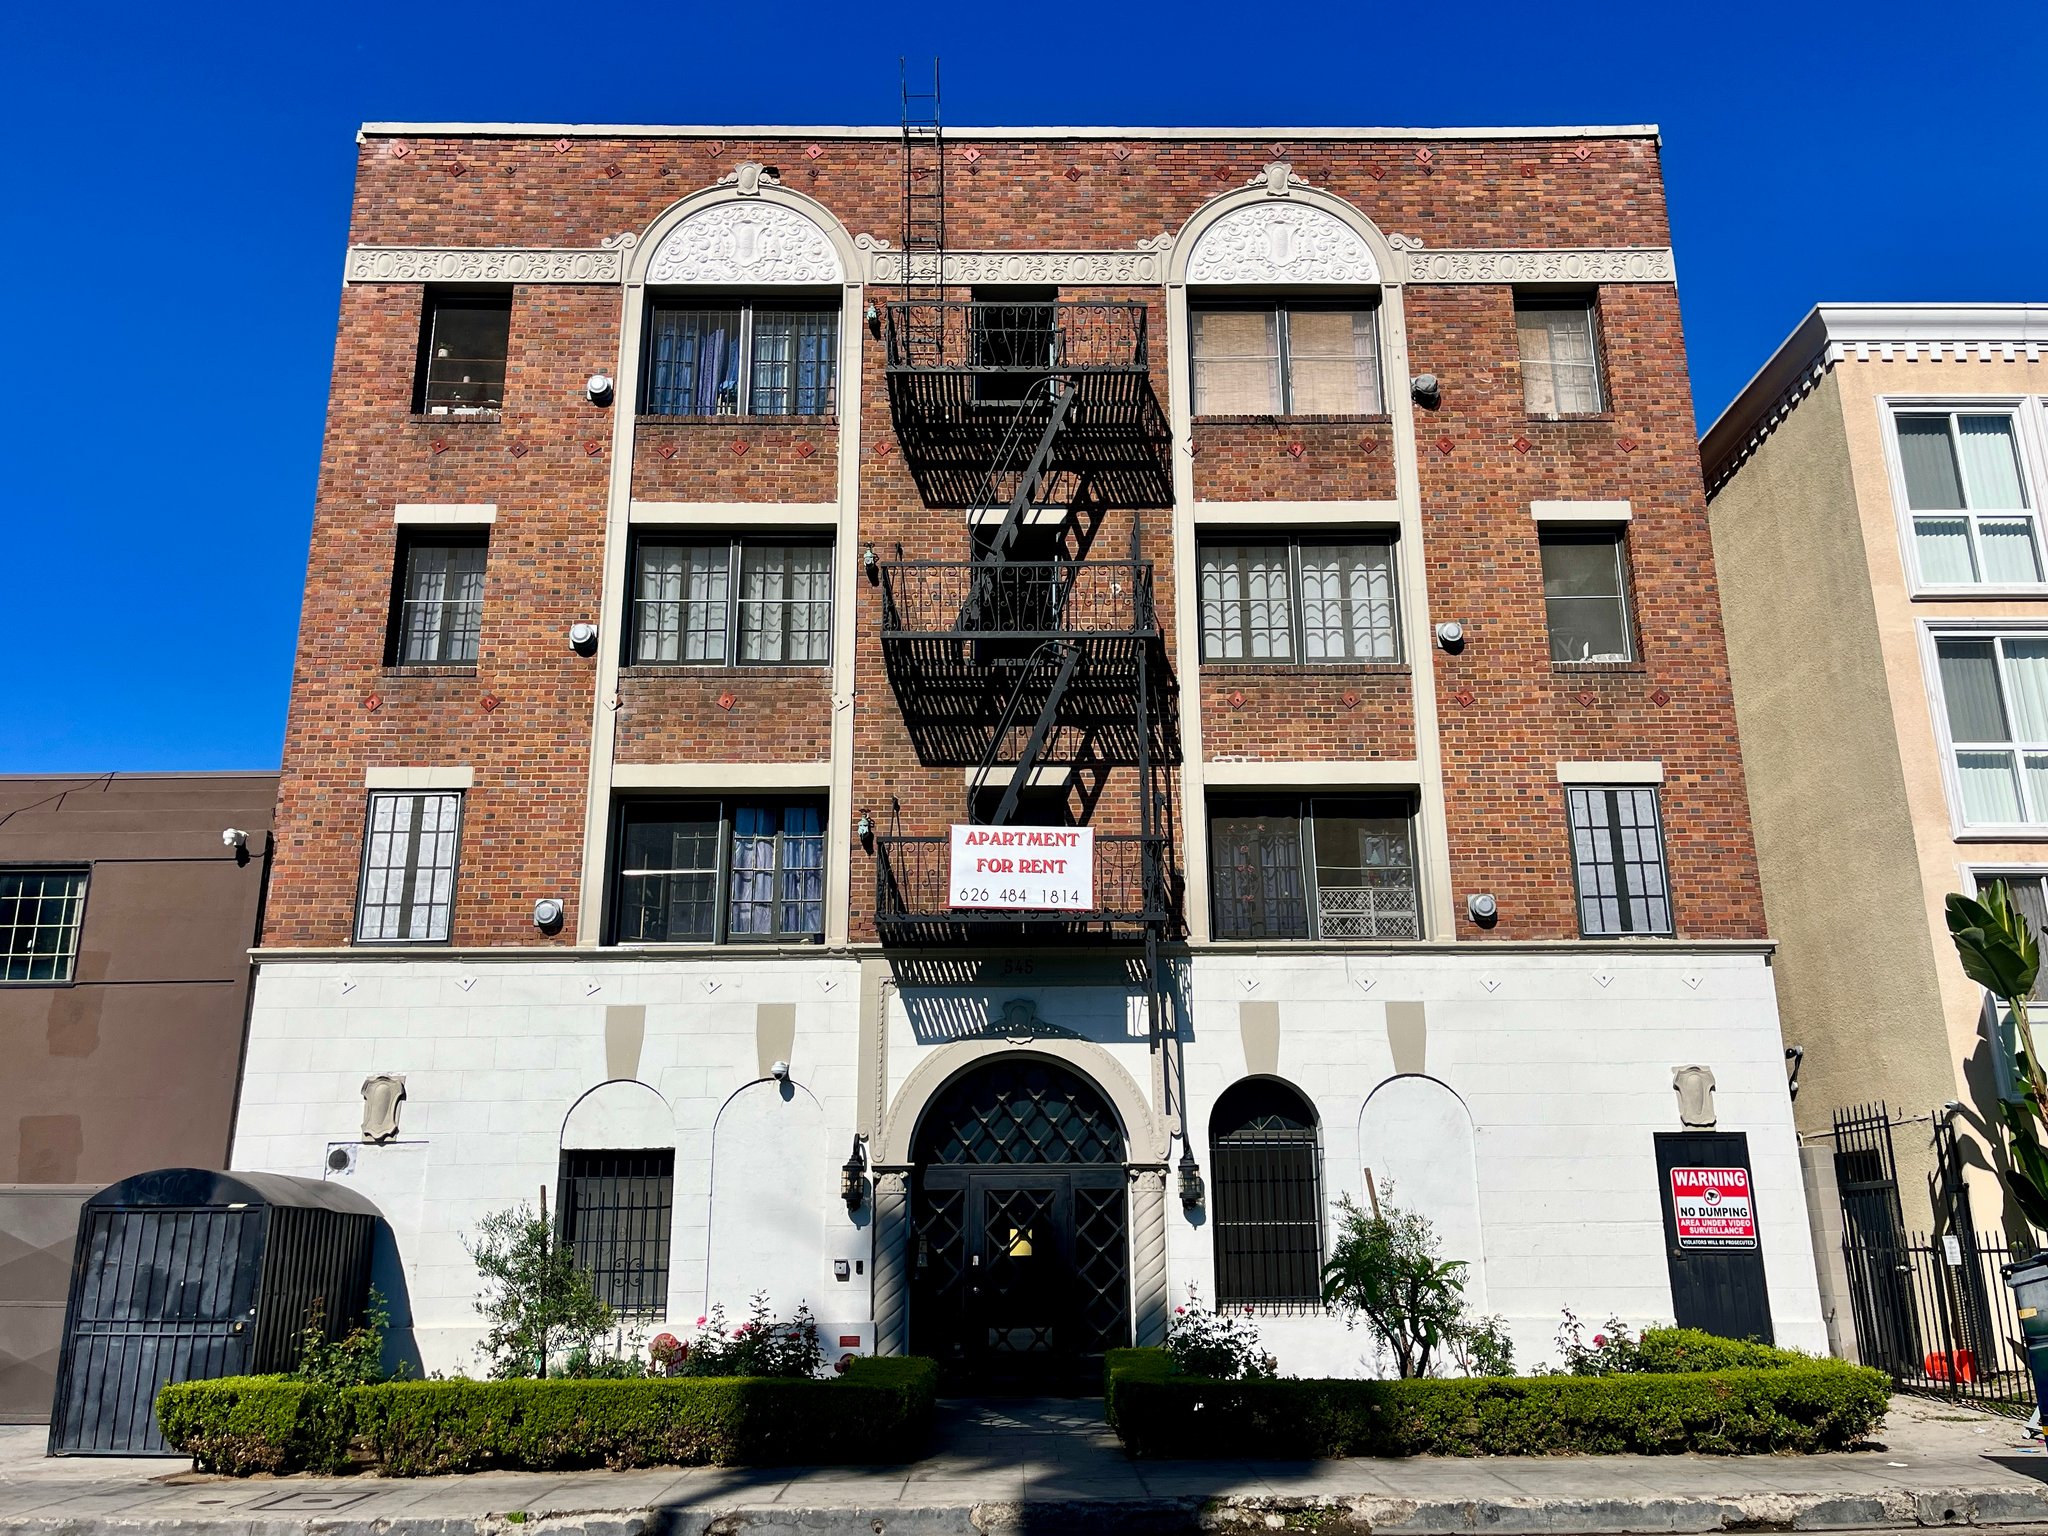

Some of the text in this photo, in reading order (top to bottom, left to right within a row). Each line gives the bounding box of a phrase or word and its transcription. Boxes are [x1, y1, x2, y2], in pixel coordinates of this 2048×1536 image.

[965, 831, 1080, 847] APARTMENT
[976, 858, 1067, 874] FOR RENT
[959, 887, 1079, 903] 626 484 1814
[1674, 1171, 1745, 1187] WARNING
[1680, 1207, 1748, 1217] NO DUMPING
[1680, 1219, 1751, 1227] AREA UNDER VIDEO
